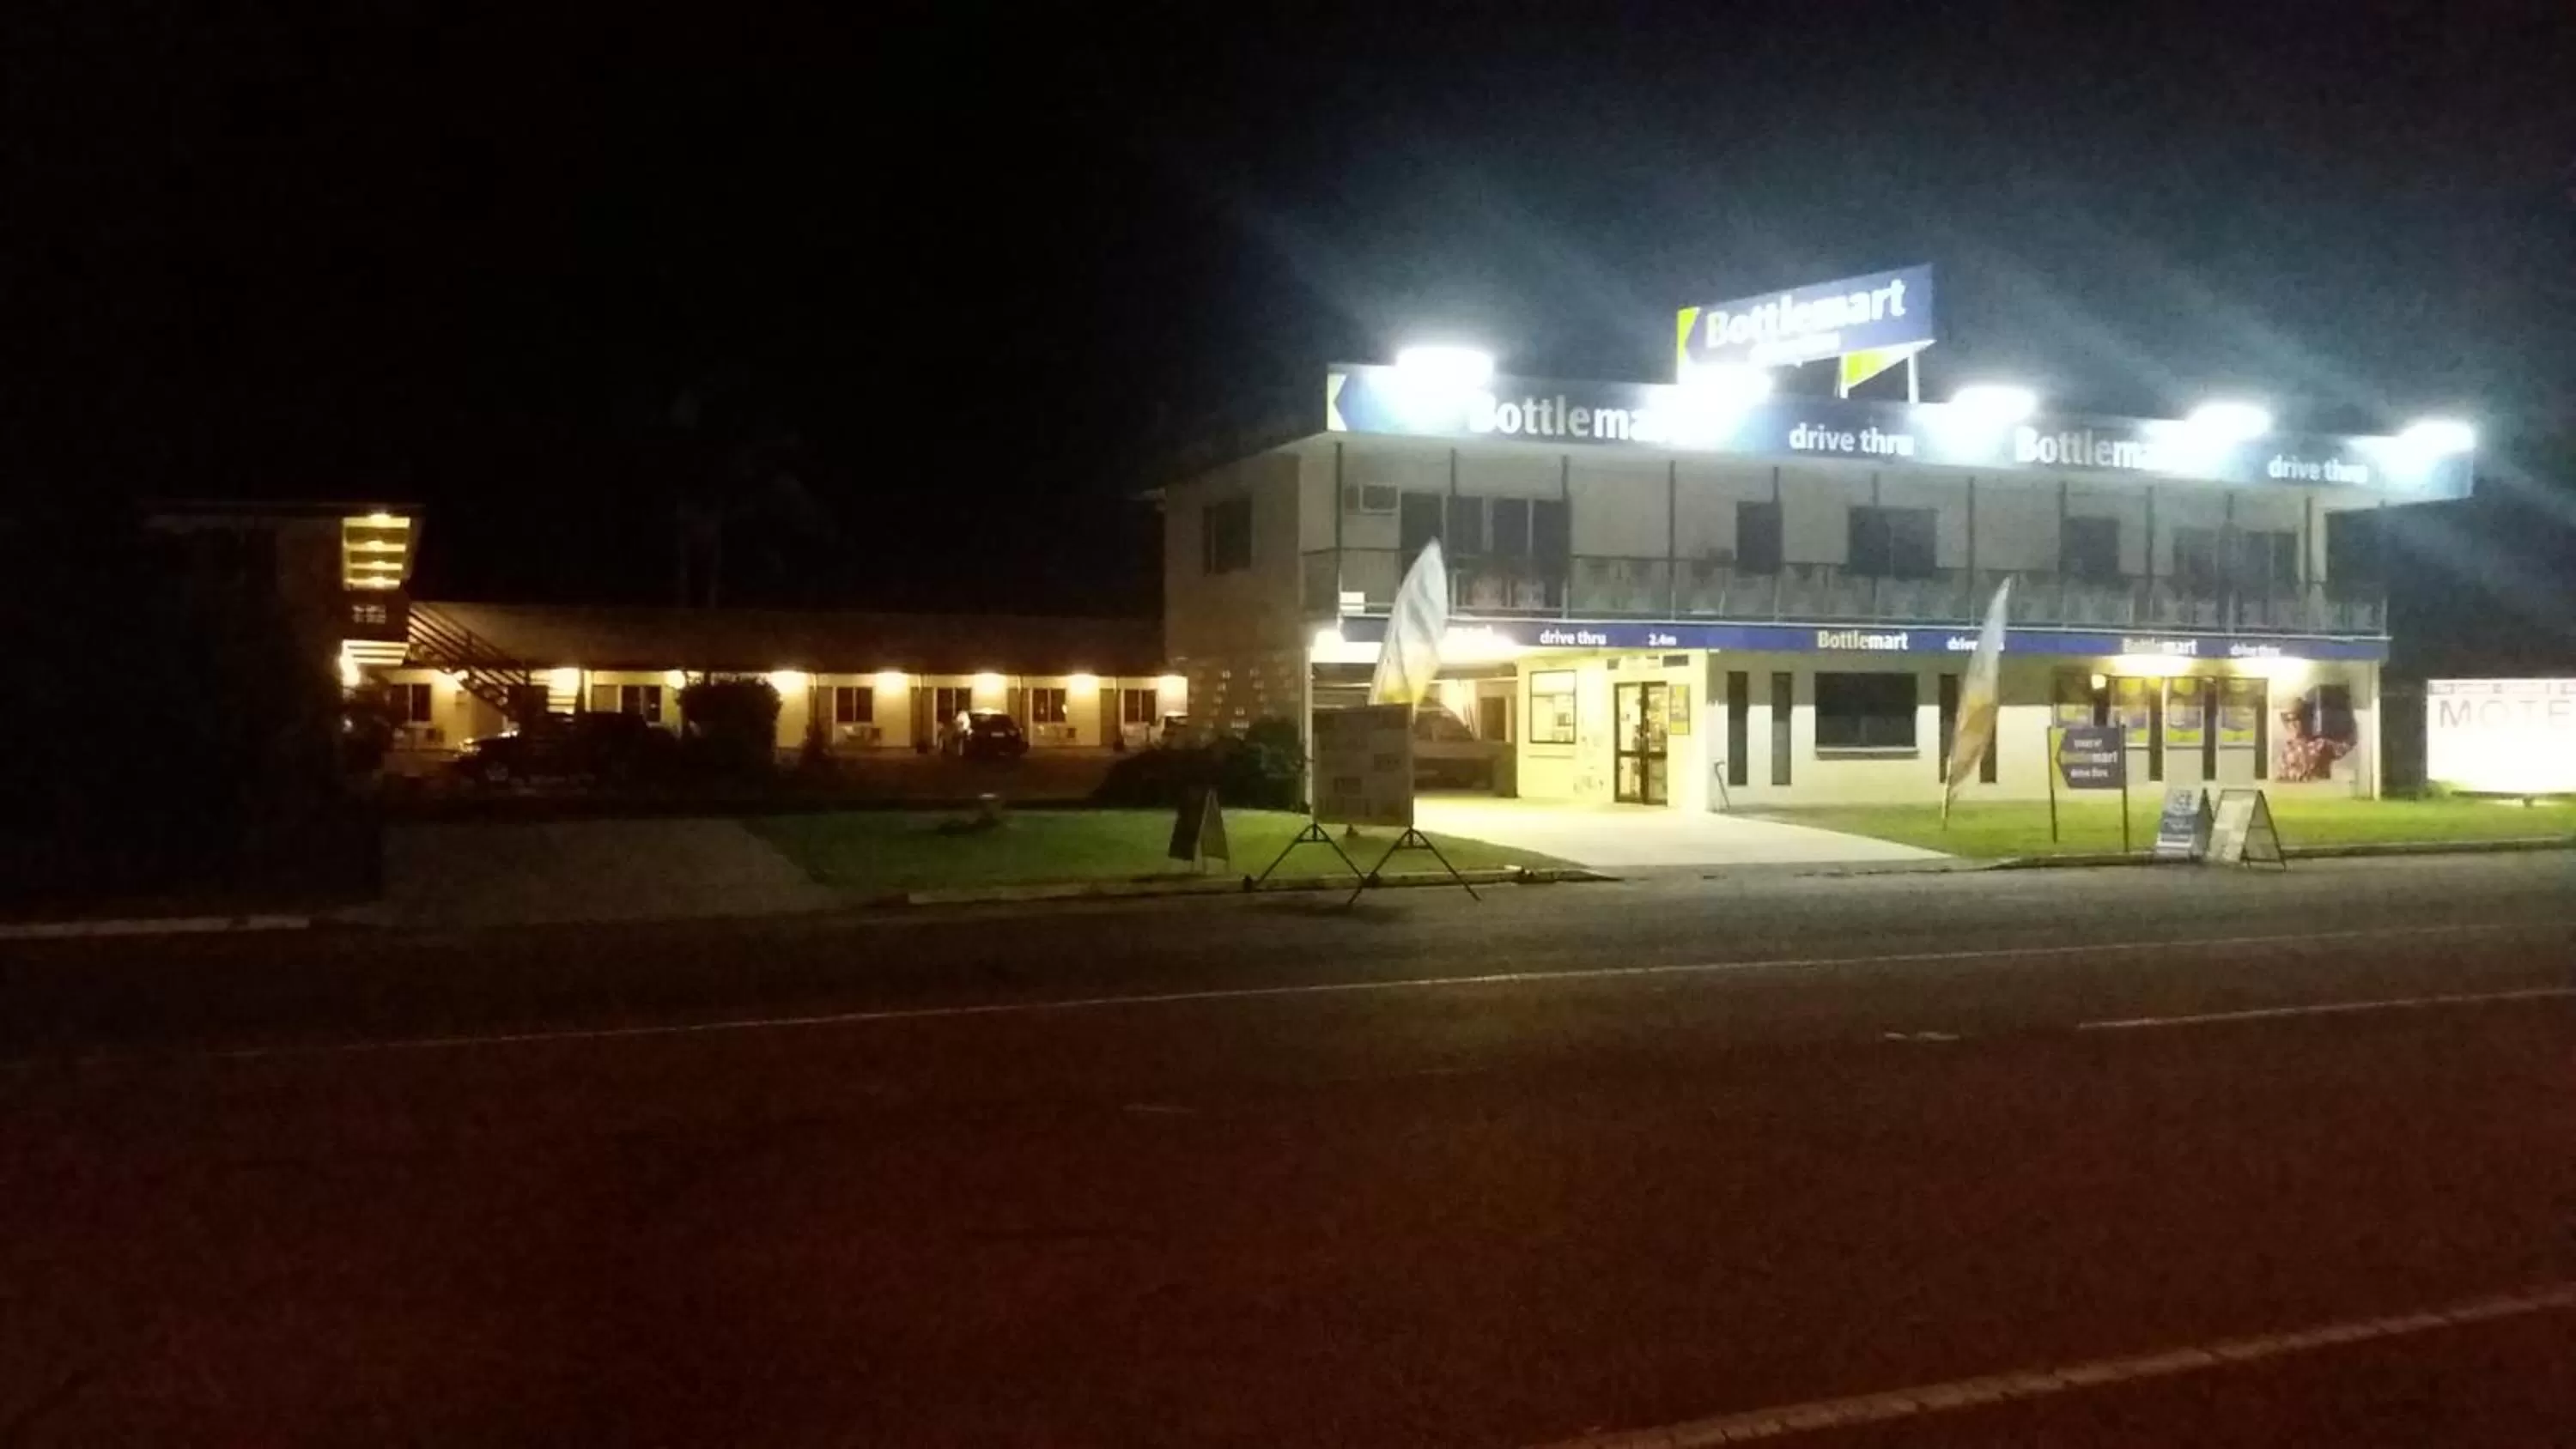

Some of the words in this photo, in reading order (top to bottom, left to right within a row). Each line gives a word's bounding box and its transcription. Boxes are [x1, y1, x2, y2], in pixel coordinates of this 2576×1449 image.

[1706, 278, 1905, 349] Bottlemart
[1469, 392, 1673, 443] Bottlema
[1789, 421, 1855, 452] drive
[1860, 427, 1915, 456] thru
[2269, 453, 2320, 481] drive
[1540, 629, 1575, 645] drive
[1577, 631, 1607, 646] thru
[1649, 633, 1676, 646] 2.4m
[1817, 630, 1909, 651] Bottlemart
